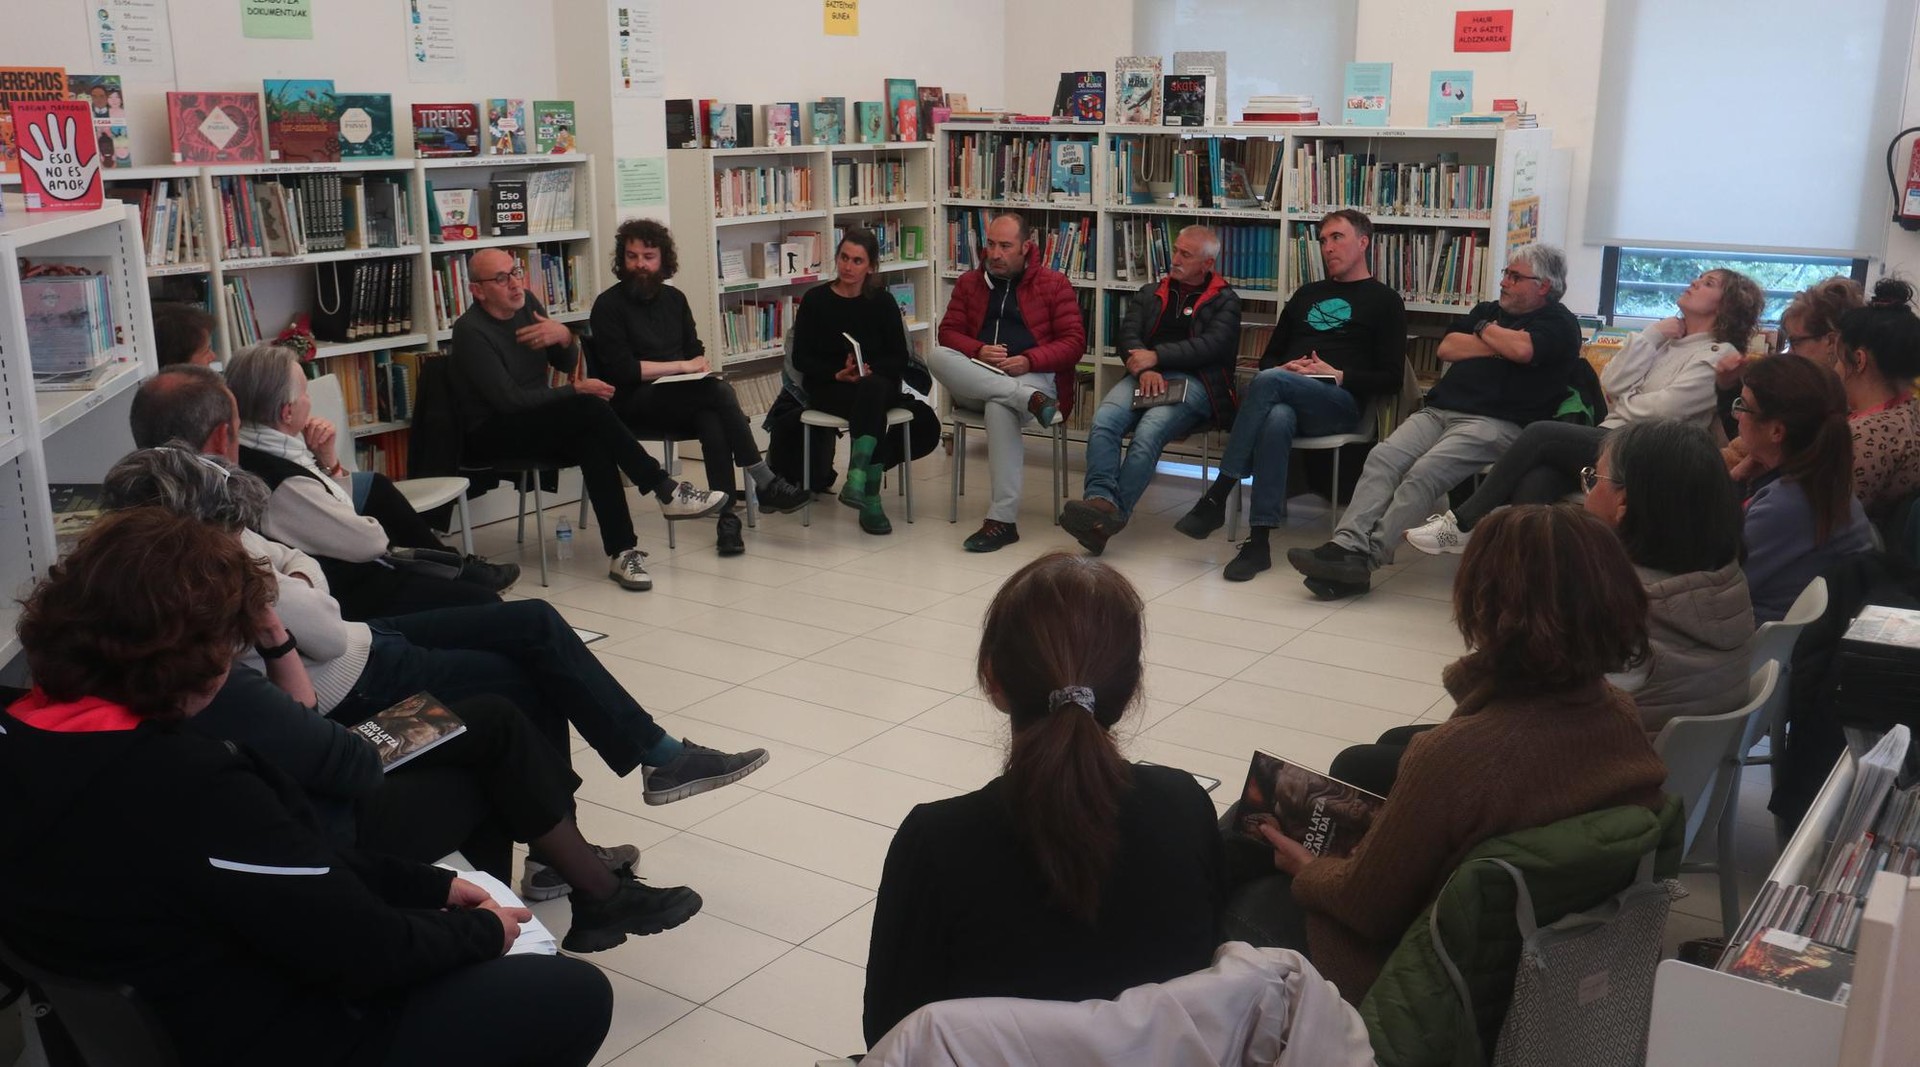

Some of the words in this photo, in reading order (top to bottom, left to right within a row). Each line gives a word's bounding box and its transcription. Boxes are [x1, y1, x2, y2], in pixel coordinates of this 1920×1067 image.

[246, 7, 308, 17] DOKUMENTUAK
[0, 71, 63, 91] ERECHOS
[419, 109, 472, 129] TRENES
[49, 153, 72, 164] ESO
[45, 167, 63, 178] NO
[68, 167, 82, 178] ES
[48, 180, 85, 191] AMOR
[500, 191, 520, 200] Eso
[497, 202, 510, 210] no
[511, 202, 523, 210] es
[498, 213, 523, 221] sexo
[357, 724, 376, 738] IZAN
[371, 735, 383, 745] DA
[365, 721, 381, 732] OSO
[377, 730, 399, 748] LATZA
[1308, 797, 1327, 832] LATZA
[1302, 833, 1315, 849] SO
[1311, 833, 1325, 857] ZAN
[1318, 817, 1331, 833] DA
